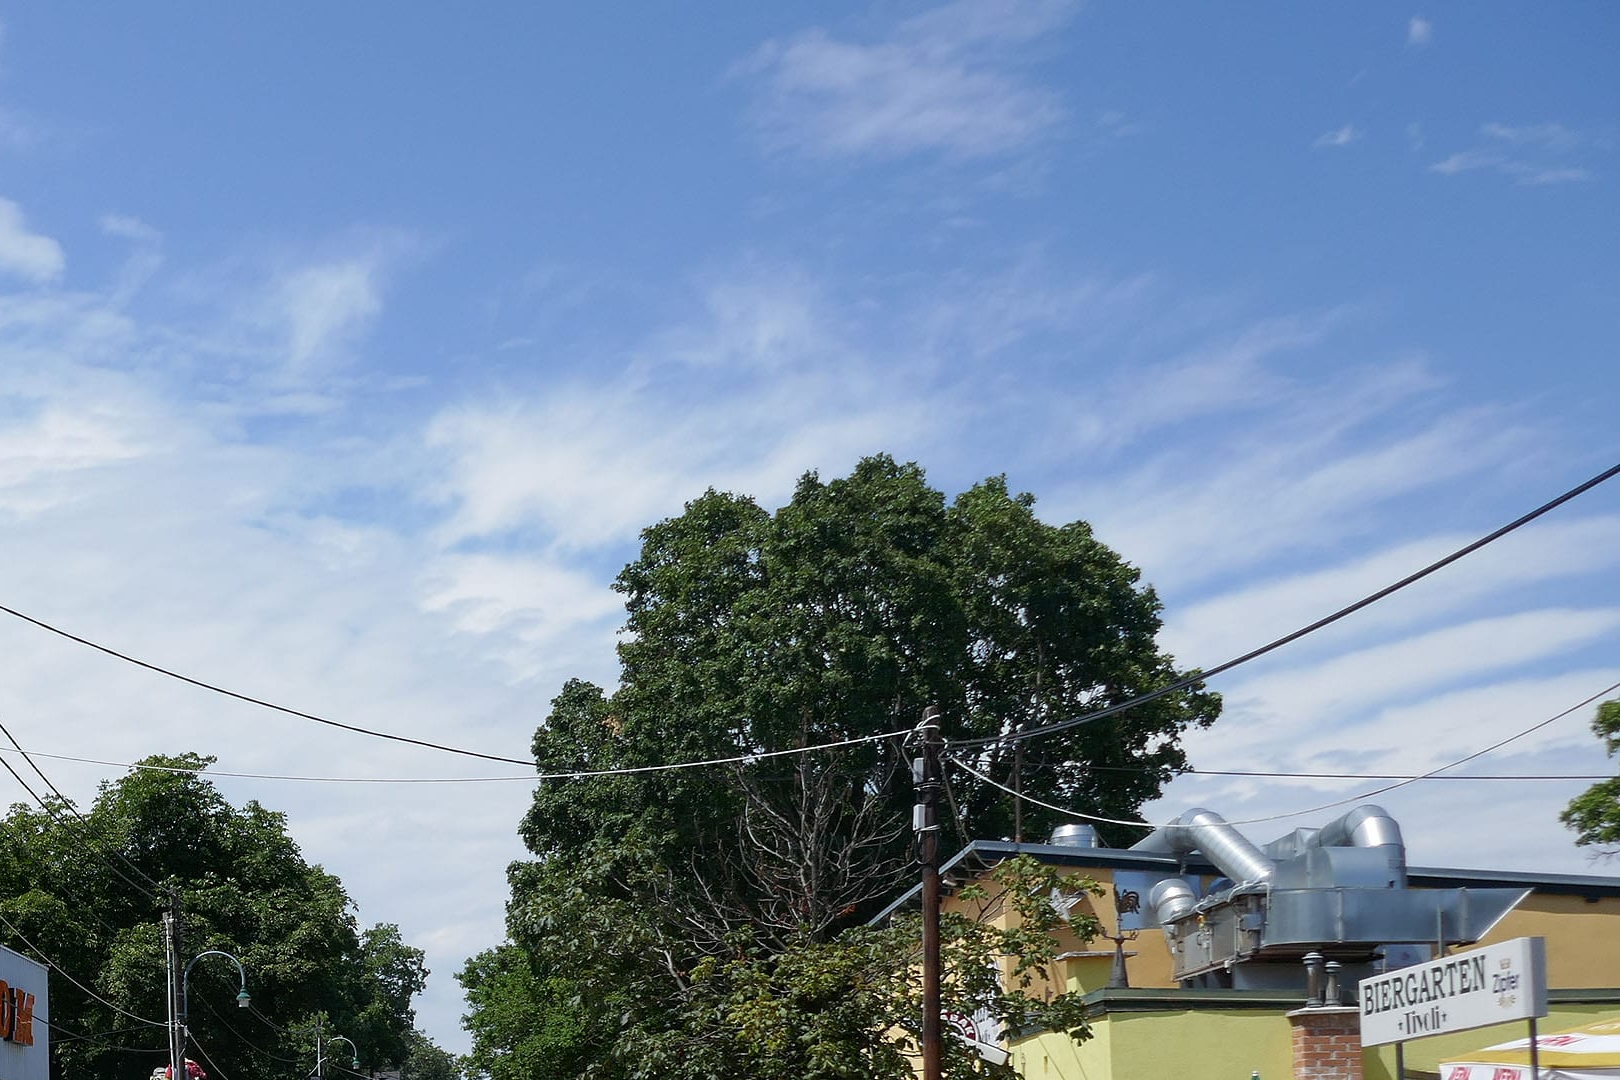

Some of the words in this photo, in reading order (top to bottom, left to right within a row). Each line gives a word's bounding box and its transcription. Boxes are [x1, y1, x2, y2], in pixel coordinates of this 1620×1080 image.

[1364, 955, 1486, 1016] BIERGARTEN
[1492, 971, 1520, 994] Zipfer
[1404, 1006, 1440, 1035] Tivoli
